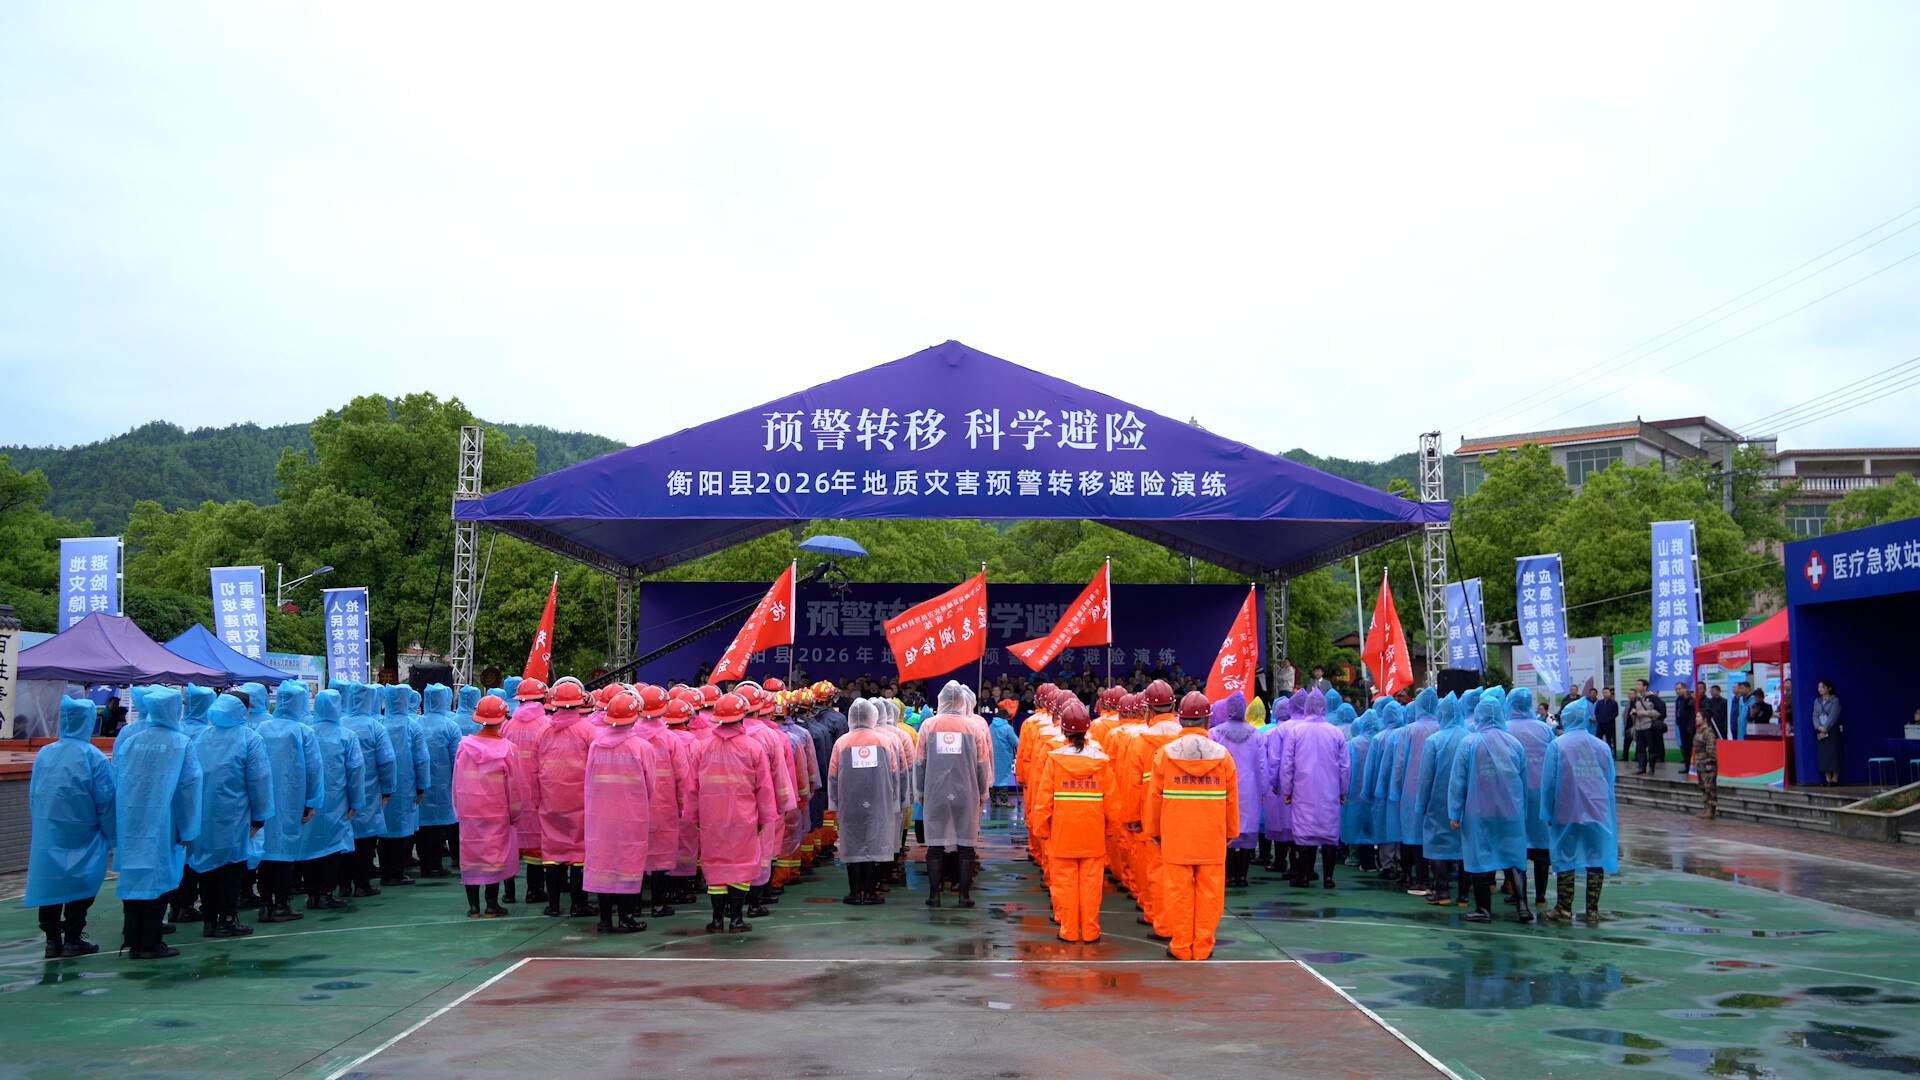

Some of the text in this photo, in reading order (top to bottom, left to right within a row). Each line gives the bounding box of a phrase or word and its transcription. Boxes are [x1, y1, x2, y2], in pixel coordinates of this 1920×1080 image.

[761, 407, 1147, 452] 预警转移 科学避险
[667, 468, 1228, 497] 衡阳县2026年地质灾害预警转移避险演练
[1832, 539, 1920, 580] 医疗急救站
[1173, 775, 1221, 786] 地质灾害防治
